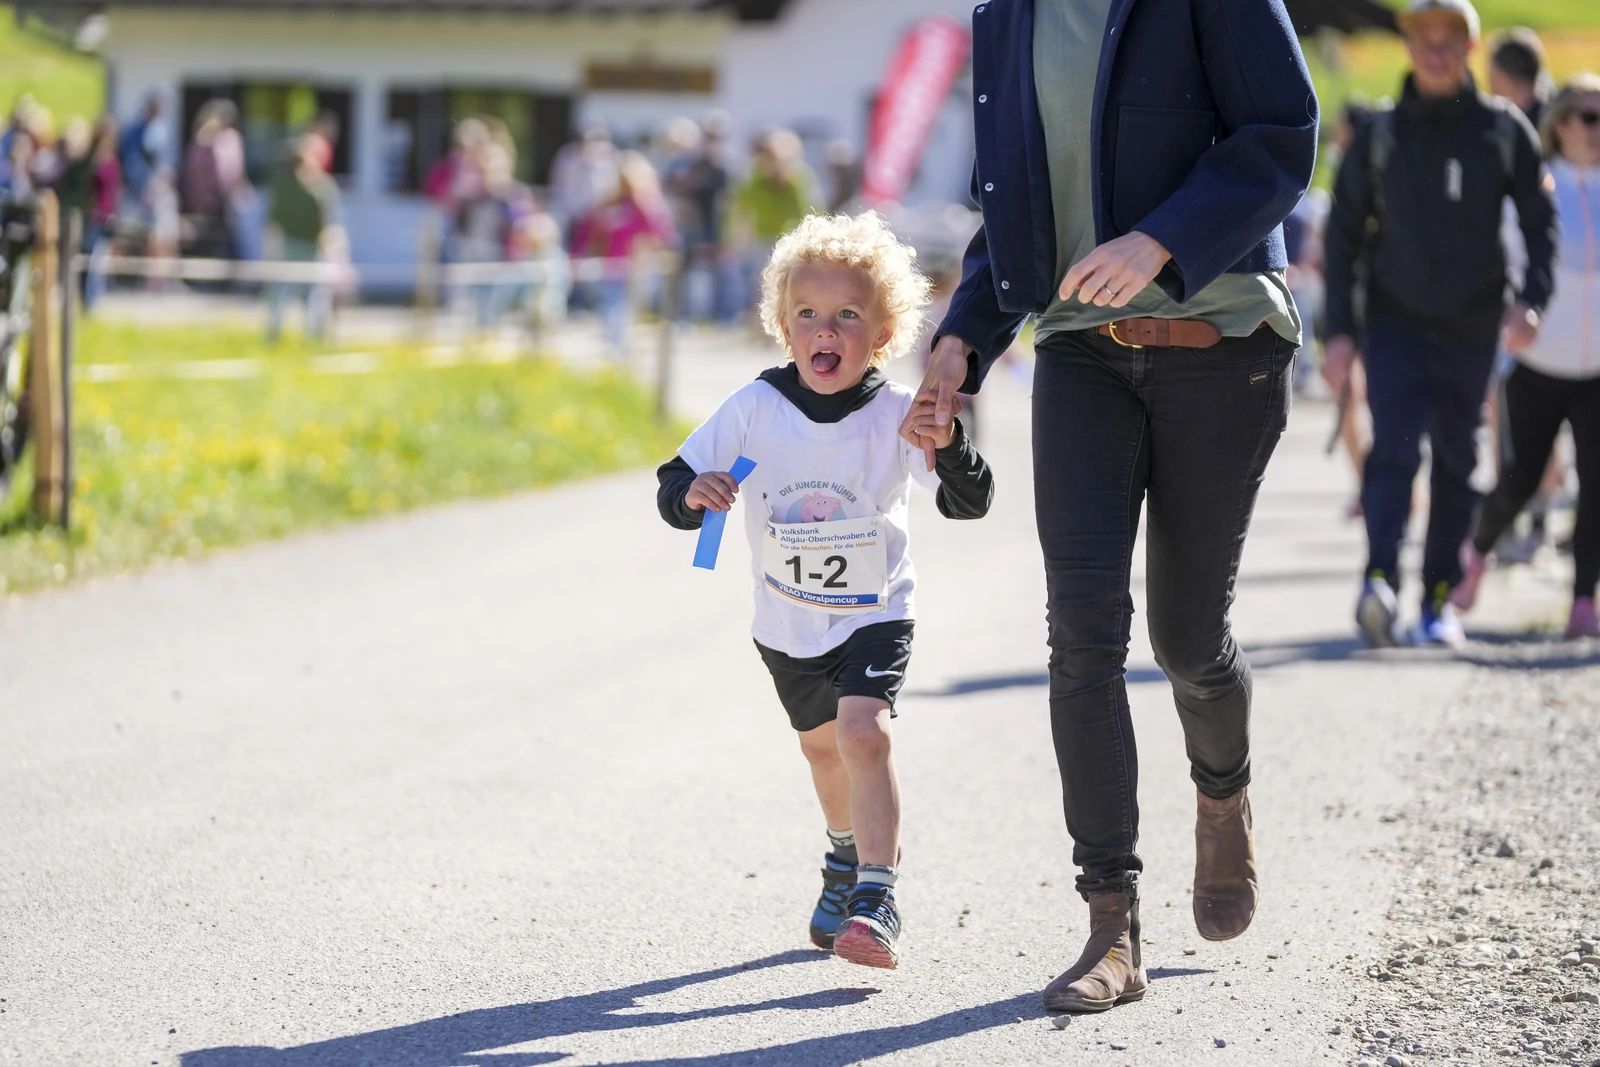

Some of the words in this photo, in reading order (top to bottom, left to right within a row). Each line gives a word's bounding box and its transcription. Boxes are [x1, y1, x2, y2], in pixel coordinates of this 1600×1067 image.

[779, 485, 794, 497] DIE
[795, 480, 829, 490] JUNGEN
[831, 482, 857, 504] HÜPFER
[780, 527, 820, 535] Volksbank
[780, 532, 866, 544] Allgäu-Oberschwaben
[867, 529, 877, 537] eG
[855, 540, 877, 548] Heimat.
[785, 555, 847, 588] 1-2
[778, 582, 800, 597] VBAO
[802, 592, 858, 605] Voralpencup
